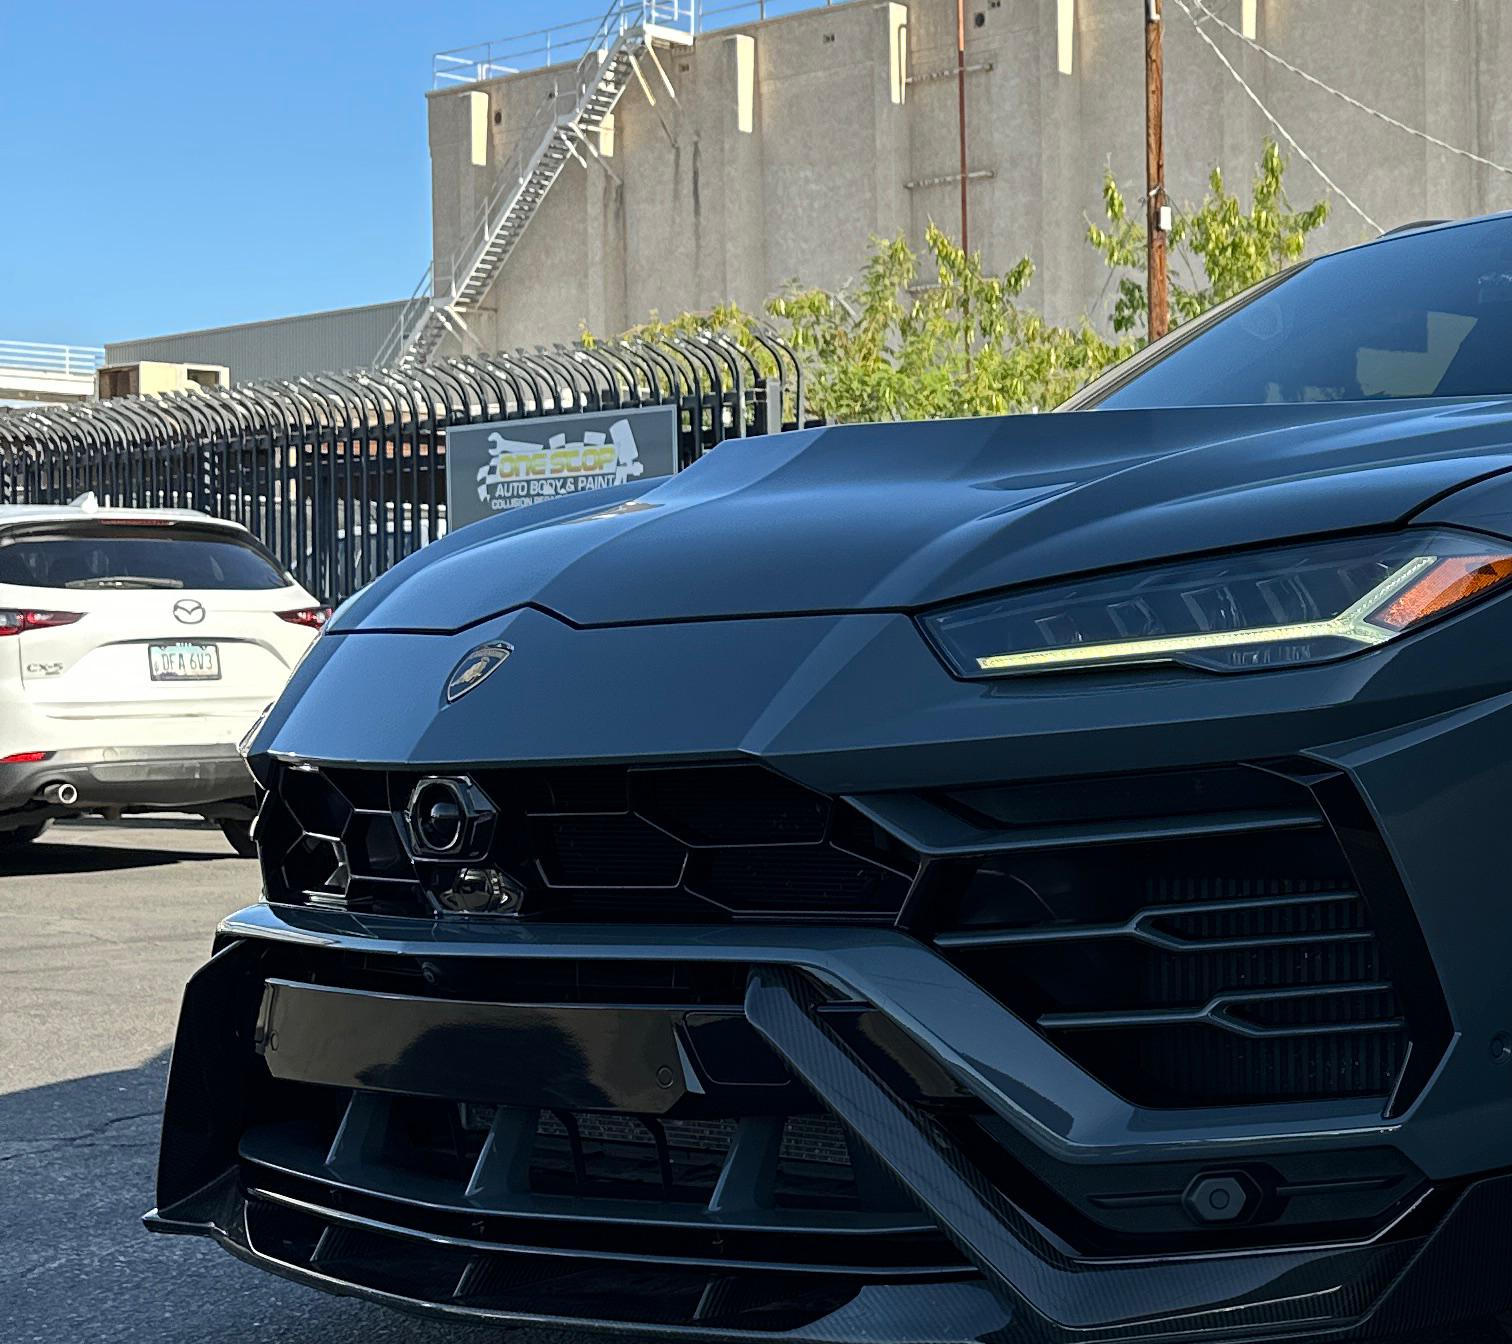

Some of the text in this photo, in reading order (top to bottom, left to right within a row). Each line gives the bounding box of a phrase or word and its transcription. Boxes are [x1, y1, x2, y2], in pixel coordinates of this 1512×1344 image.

[500, 447, 615, 478] ONE STOP
[495, 474, 615, 498] AUTO BODY & PAINT
[27, 660, 64, 672] CX-5
